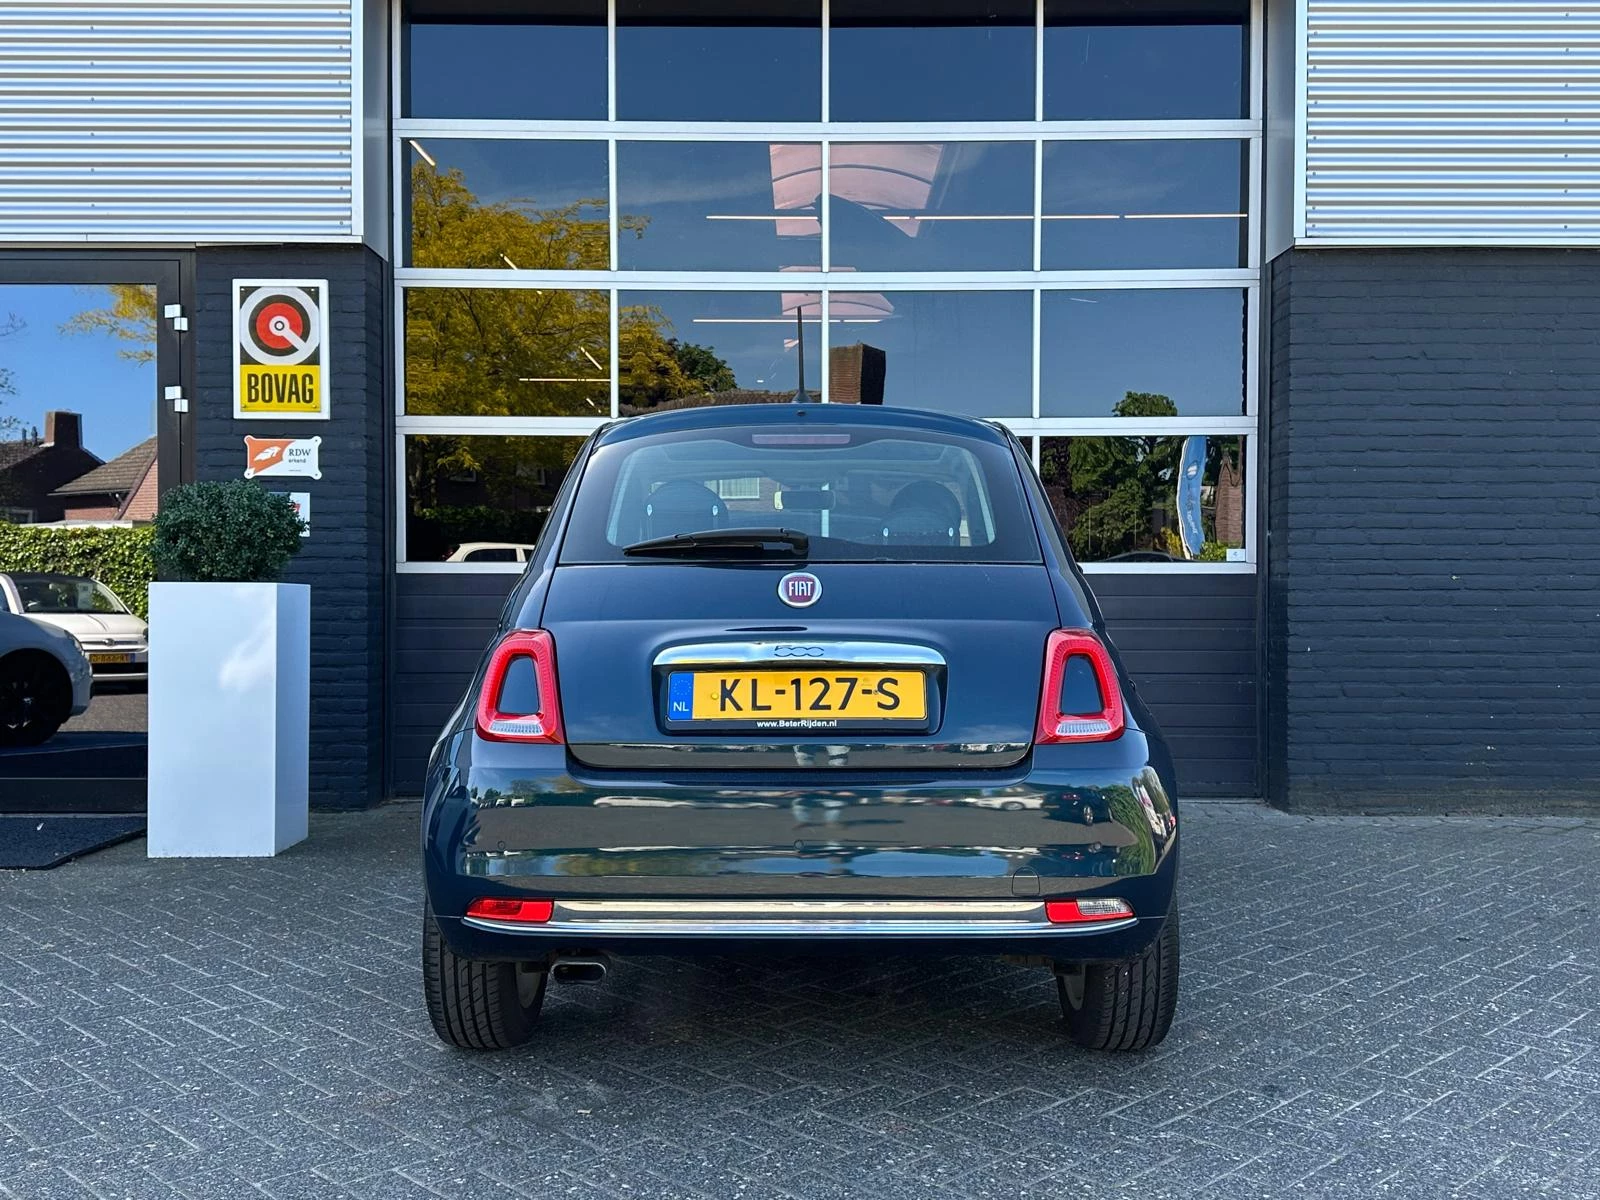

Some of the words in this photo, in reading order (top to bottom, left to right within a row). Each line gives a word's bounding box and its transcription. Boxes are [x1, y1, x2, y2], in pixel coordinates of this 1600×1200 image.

[247, 373, 314, 404] BOVAG
[288, 448, 311, 457] RDW
[788, 581, 813, 597] FIAT
[774, 645, 825, 657] 500
[719, 677, 901, 711] KL-127-S
[673, 702, 689, 712] NL
